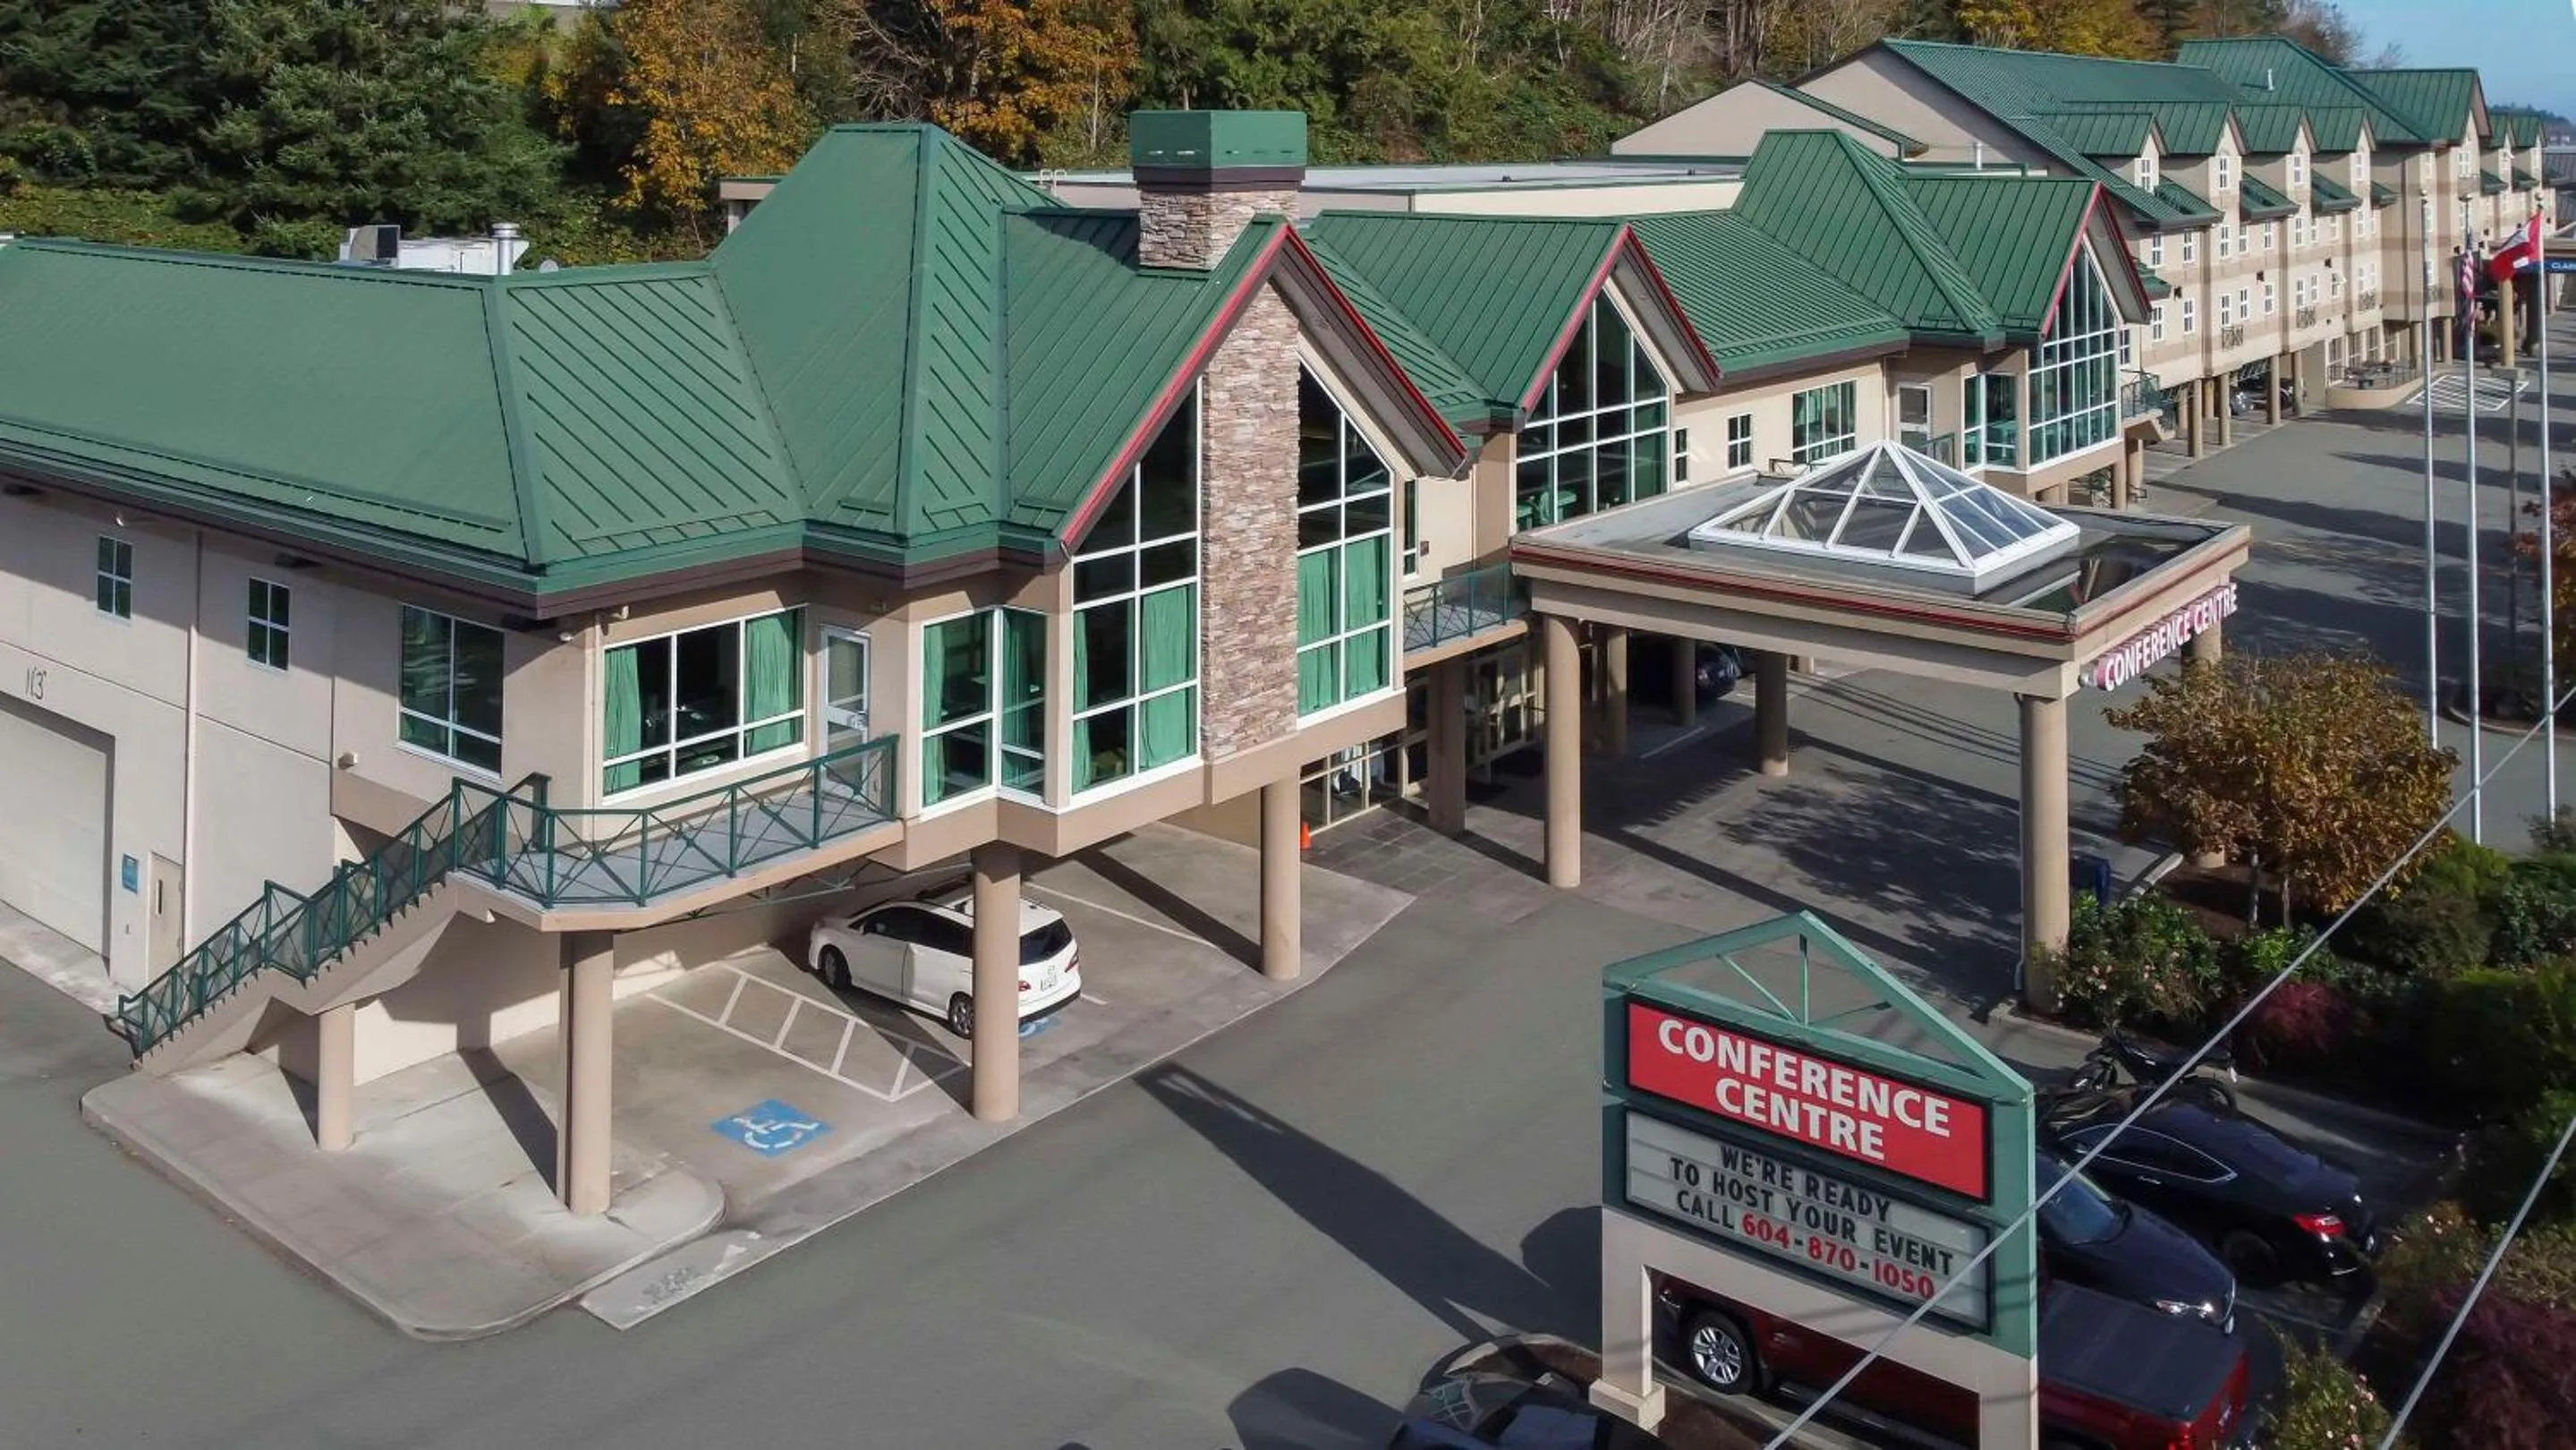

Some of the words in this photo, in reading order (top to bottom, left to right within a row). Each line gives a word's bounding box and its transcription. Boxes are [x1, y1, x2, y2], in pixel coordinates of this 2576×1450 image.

[2104, 610, 2191, 691] CONFERENCE
[2194, 583, 2237, 635] CENTRE
[1658, 1019, 1950, 1138] CONFERENCE
[1715, 1078, 1884, 1161] CENTRE
[1671, 1157, 1699, 1186] TO
[1713, 1172, 1773, 1212] HOST
[1786, 1198, 1857, 1243] YOUR
[1875, 1228, 1953, 1275] EVENT
[1721, 1146, 1793, 1191] WE'RE
[1805, 1173, 1891, 1222] READY
[1677, 1190, 1734, 1229] CALL
[1742, 1213, 1934, 1298] 604-870-1050
